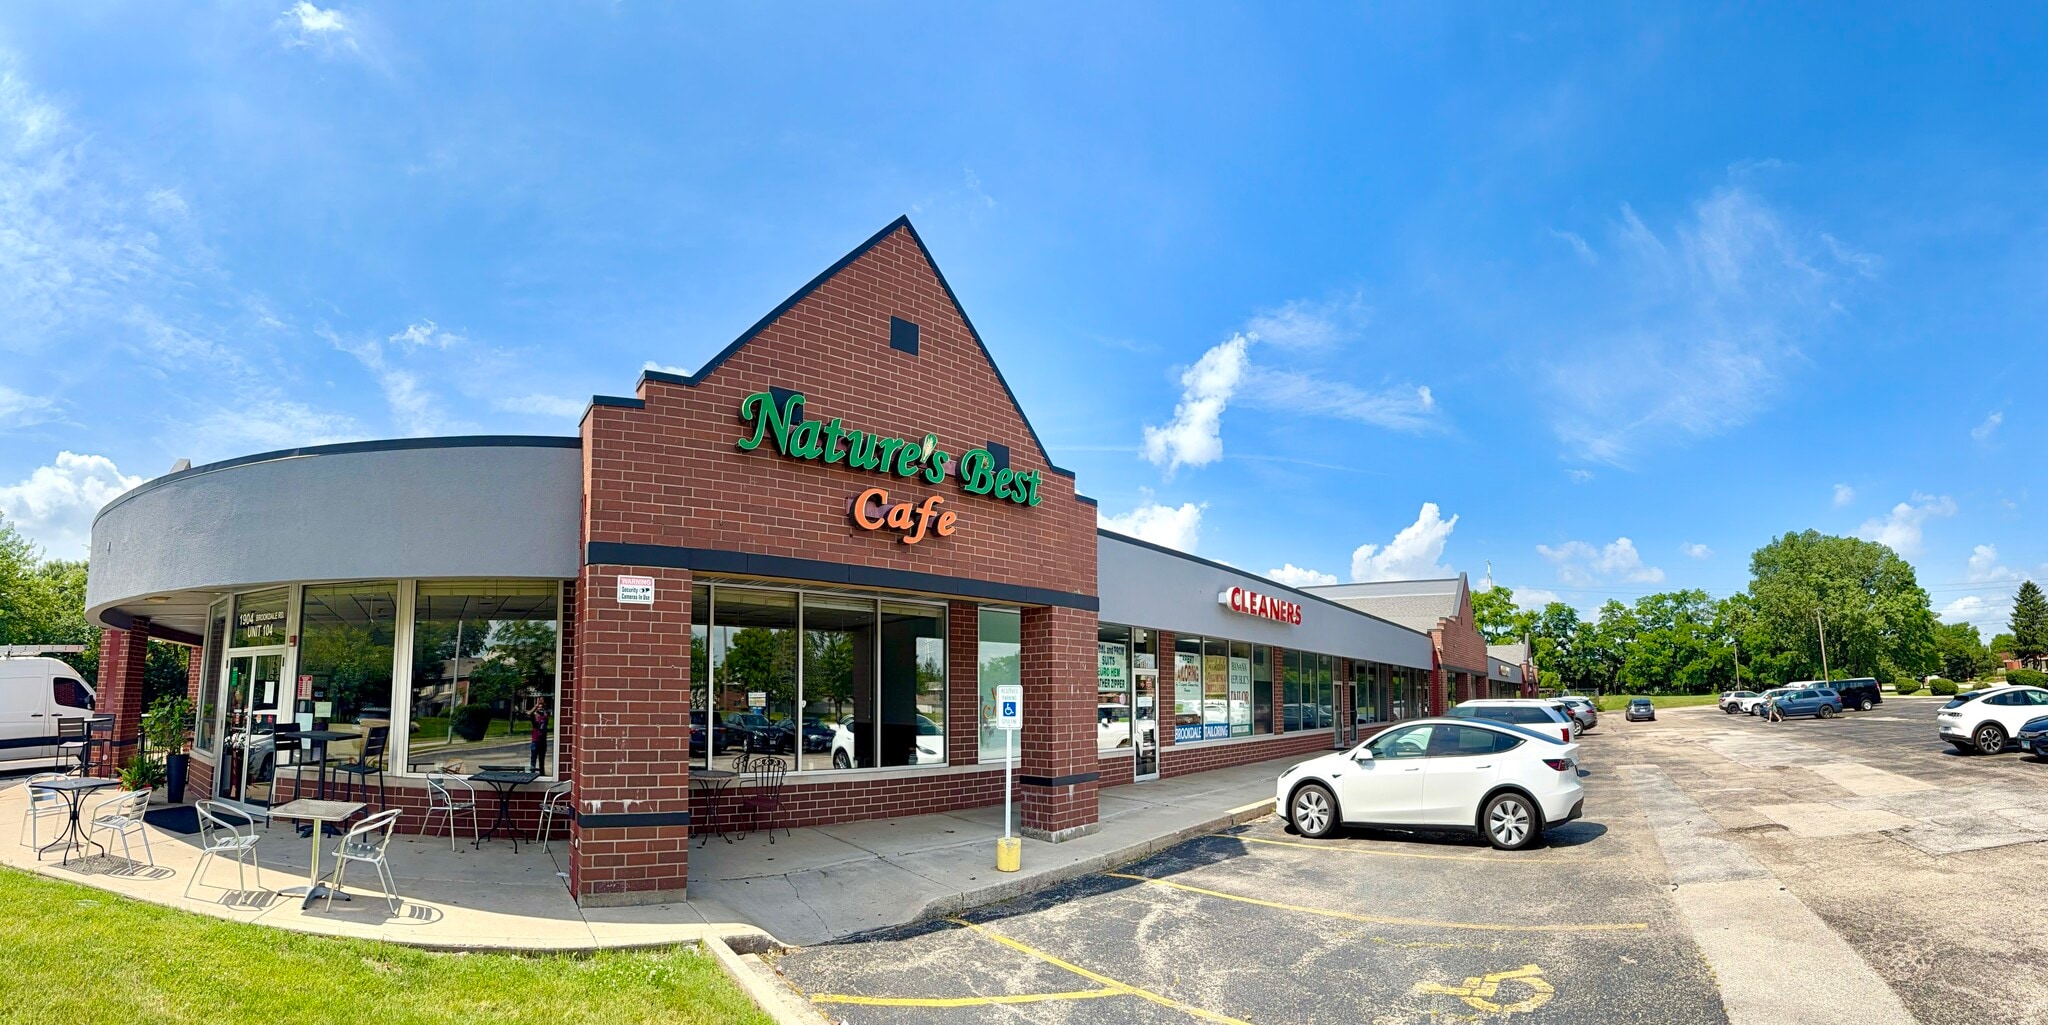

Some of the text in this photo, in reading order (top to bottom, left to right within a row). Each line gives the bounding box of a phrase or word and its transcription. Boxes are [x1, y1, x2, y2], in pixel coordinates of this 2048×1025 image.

[738, 391, 1042, 507] Nature's Best
[854, 488, 957, 544] Cafe
[621, 586, 638, 594] Security
[1231, 586, 1302, 625] CLEANERS
[240, 613, 254, 626] 1904
[247, 624, 273, 638] UNIT 104
[1102, 656, 1115, 666] SUITS
[1111, 679, 1125, 688] ZIPPER
[1230, 690, 1249, 704] TAILOR
[1175, 726, 1202, 739] BROOKDALE
[1205, 725, 1228, 737] TAILORING
